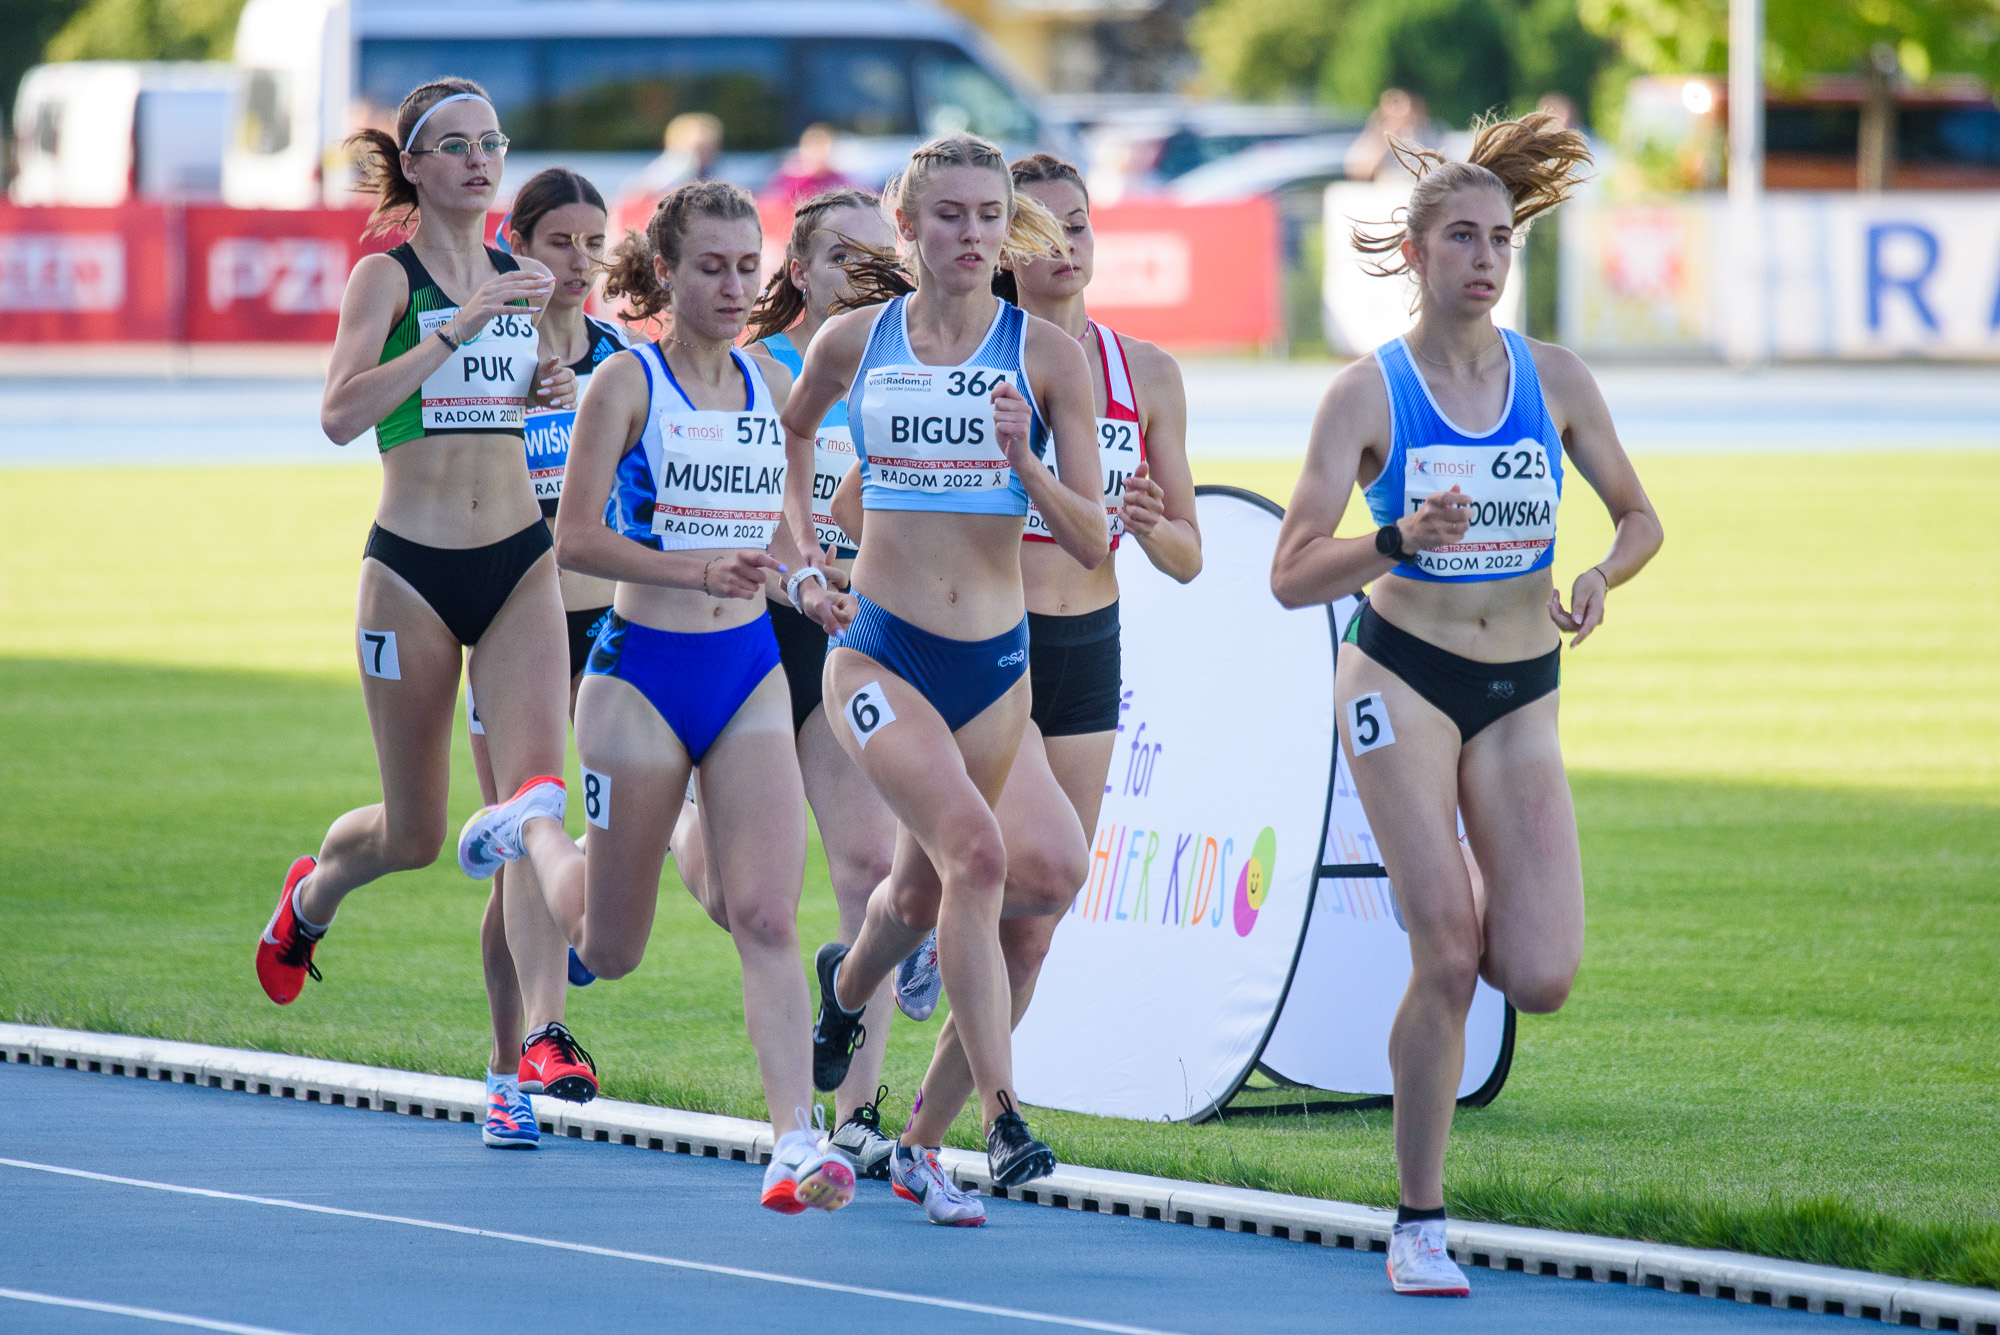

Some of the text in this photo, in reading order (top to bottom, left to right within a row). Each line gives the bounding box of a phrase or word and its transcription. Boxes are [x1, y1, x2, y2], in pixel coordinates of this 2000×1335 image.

[463, 356, 516, 383] PUK
[434, 410, 518, 424] RADOM 2022
[687, 424, 724, 439] mosir
[737, 417, 782, 446] 571
[891, 415, 985, 445] BIGUS
[1096, 423, 1134, 452] 92
[871, 456, 891, 465] PZLA
[894, 458, 955, 469] MISTRZOSTWA
[956, 461, 989, 469] POLSKI
[1433, 460, 1476, 475] mosir
[1491, 450, 1546, 480] 625
[664, 461, 785, 495] MUSIELAK
[880, 469, 983, 488] RADOM 2022
[658, 504, 683, 516] PZLA
[684, 509, 744, 519] MISTRZOSTWA
[745, 512, 769, 520] POLSKI
[1411, 497, 1551, 528] TDOWSKA
[664, 519, 764, 539] RADOM 2022
[1499, 541, 1531, 550] POLSKI
[1532, 540, 1550, 548] U20
[1484, 554, 1523, 569] 2022
[364, 632, 387, 674] 7
[851, 691, 880, 734] 6
[1355, 697, 1380, 747] 5
[1123, 722, 1162, 798] for
[584, 773, 601, 820] 8
[1072, 823, 1160, 924] HIER
[1162, 832, 1234, 929] KIDS
